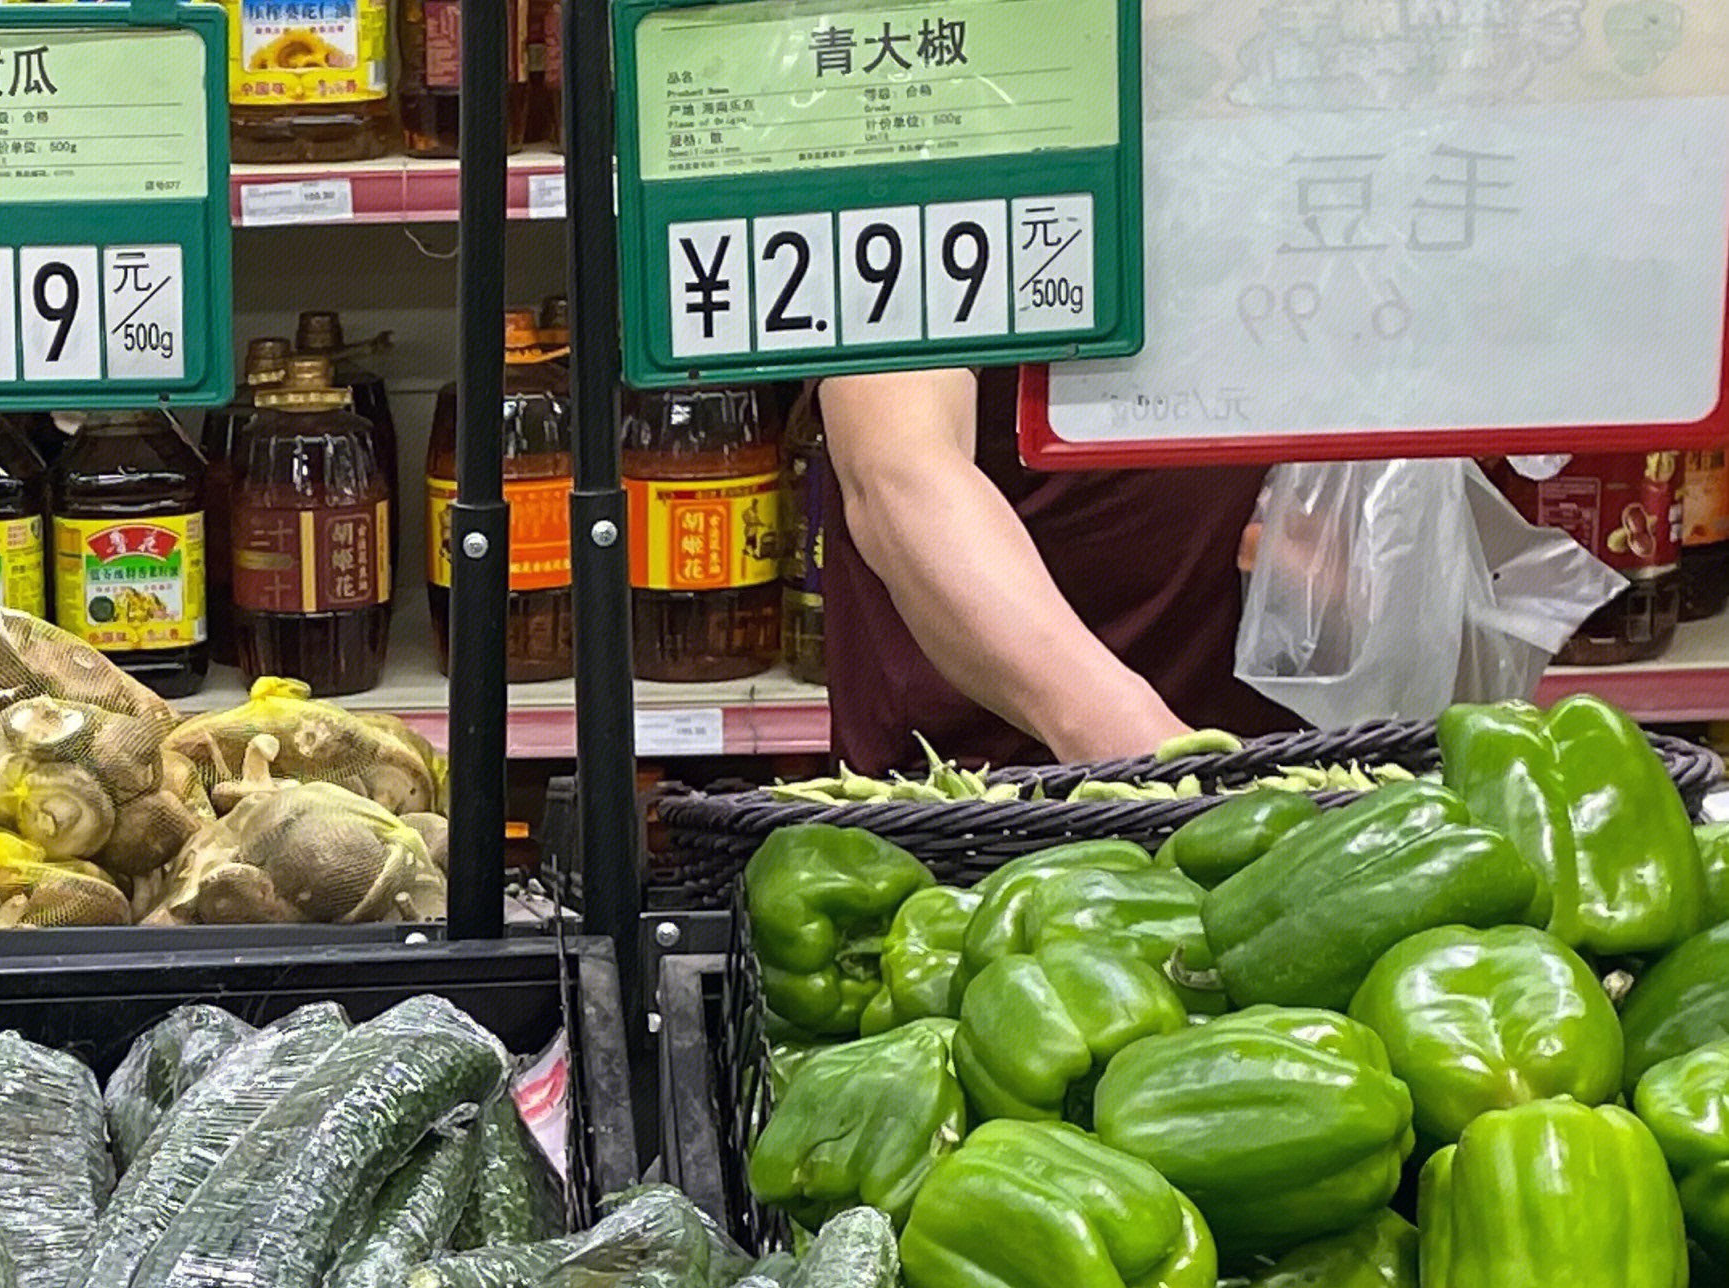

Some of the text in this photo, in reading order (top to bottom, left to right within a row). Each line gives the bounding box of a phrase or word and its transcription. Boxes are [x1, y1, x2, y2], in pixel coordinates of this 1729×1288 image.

[808, 16, 968, 78] 青大椒
[331, 521, 356, 598] 胡姬花
